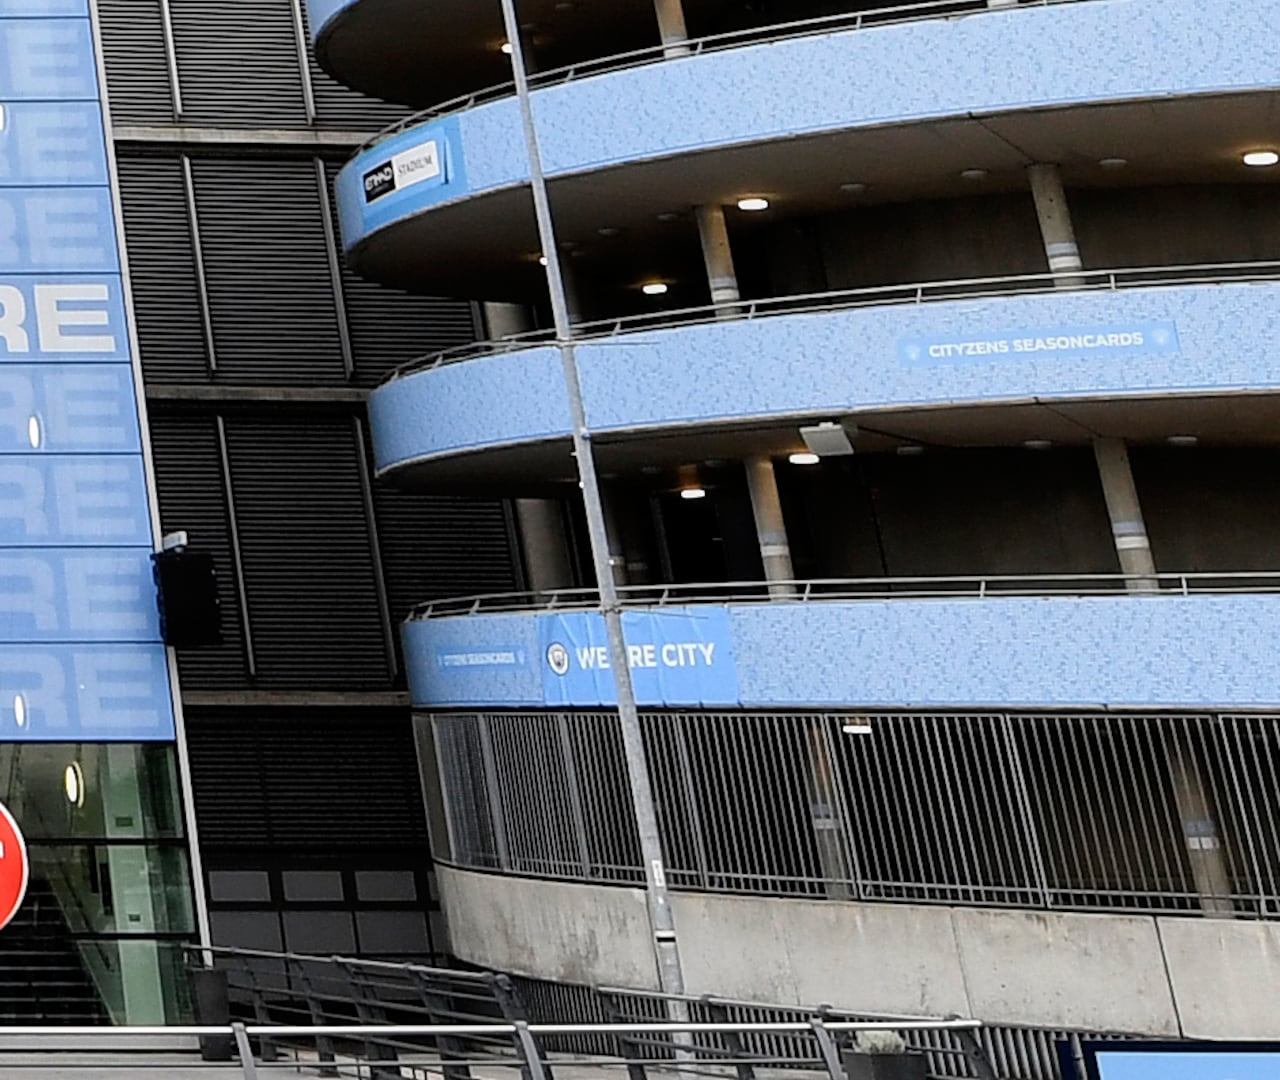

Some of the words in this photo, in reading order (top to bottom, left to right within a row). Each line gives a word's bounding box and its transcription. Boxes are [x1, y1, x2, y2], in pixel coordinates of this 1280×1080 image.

[928, 340, 1009, 358] CITYZENS
[1013, 331, 1144, 353] SEASONCARDS
[576, 646, 611, 669] WE
[627, 644, 657, 668] RE
[661, 642, 715, 667] CITY
